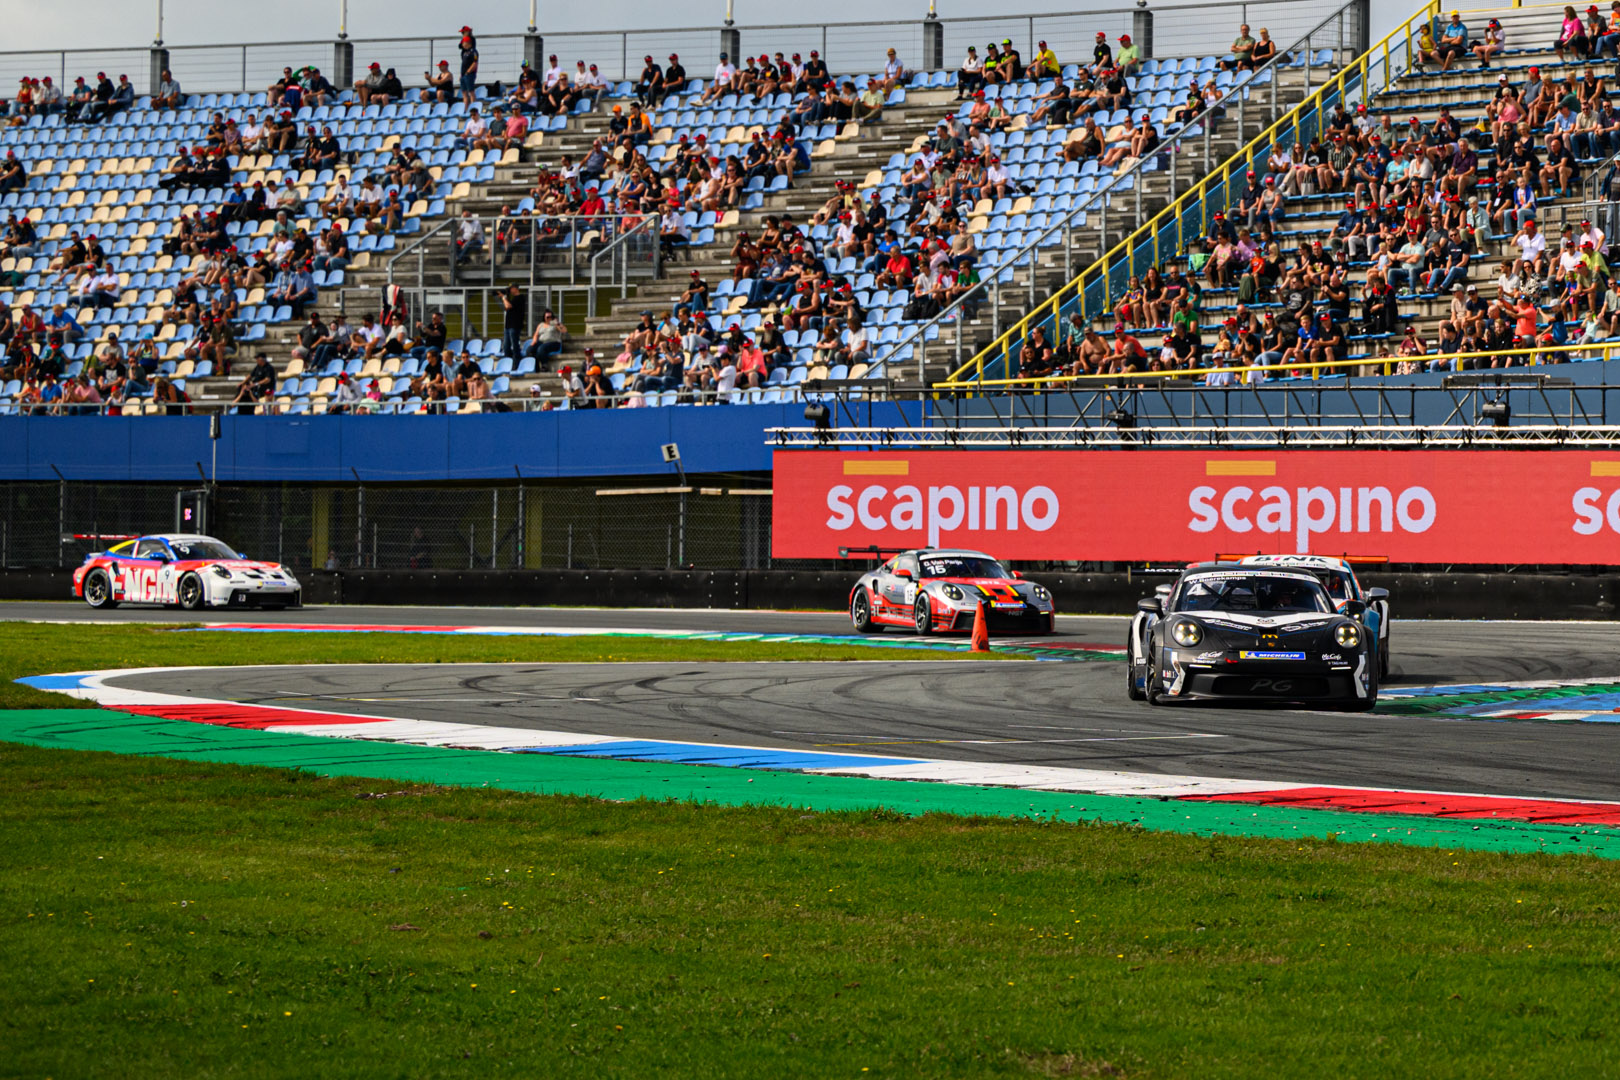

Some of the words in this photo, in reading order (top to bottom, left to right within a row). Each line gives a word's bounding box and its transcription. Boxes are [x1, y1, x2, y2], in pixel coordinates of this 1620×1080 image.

[665, 445, 676, 459] E
[827, 486, 1059, 552] scapino
[1189, 486, 1436, 553] scapino
[180, 546, 190, 554] 9
[926, 565, 946, 575] 15
[1187, 583, 1206, 596] 4
